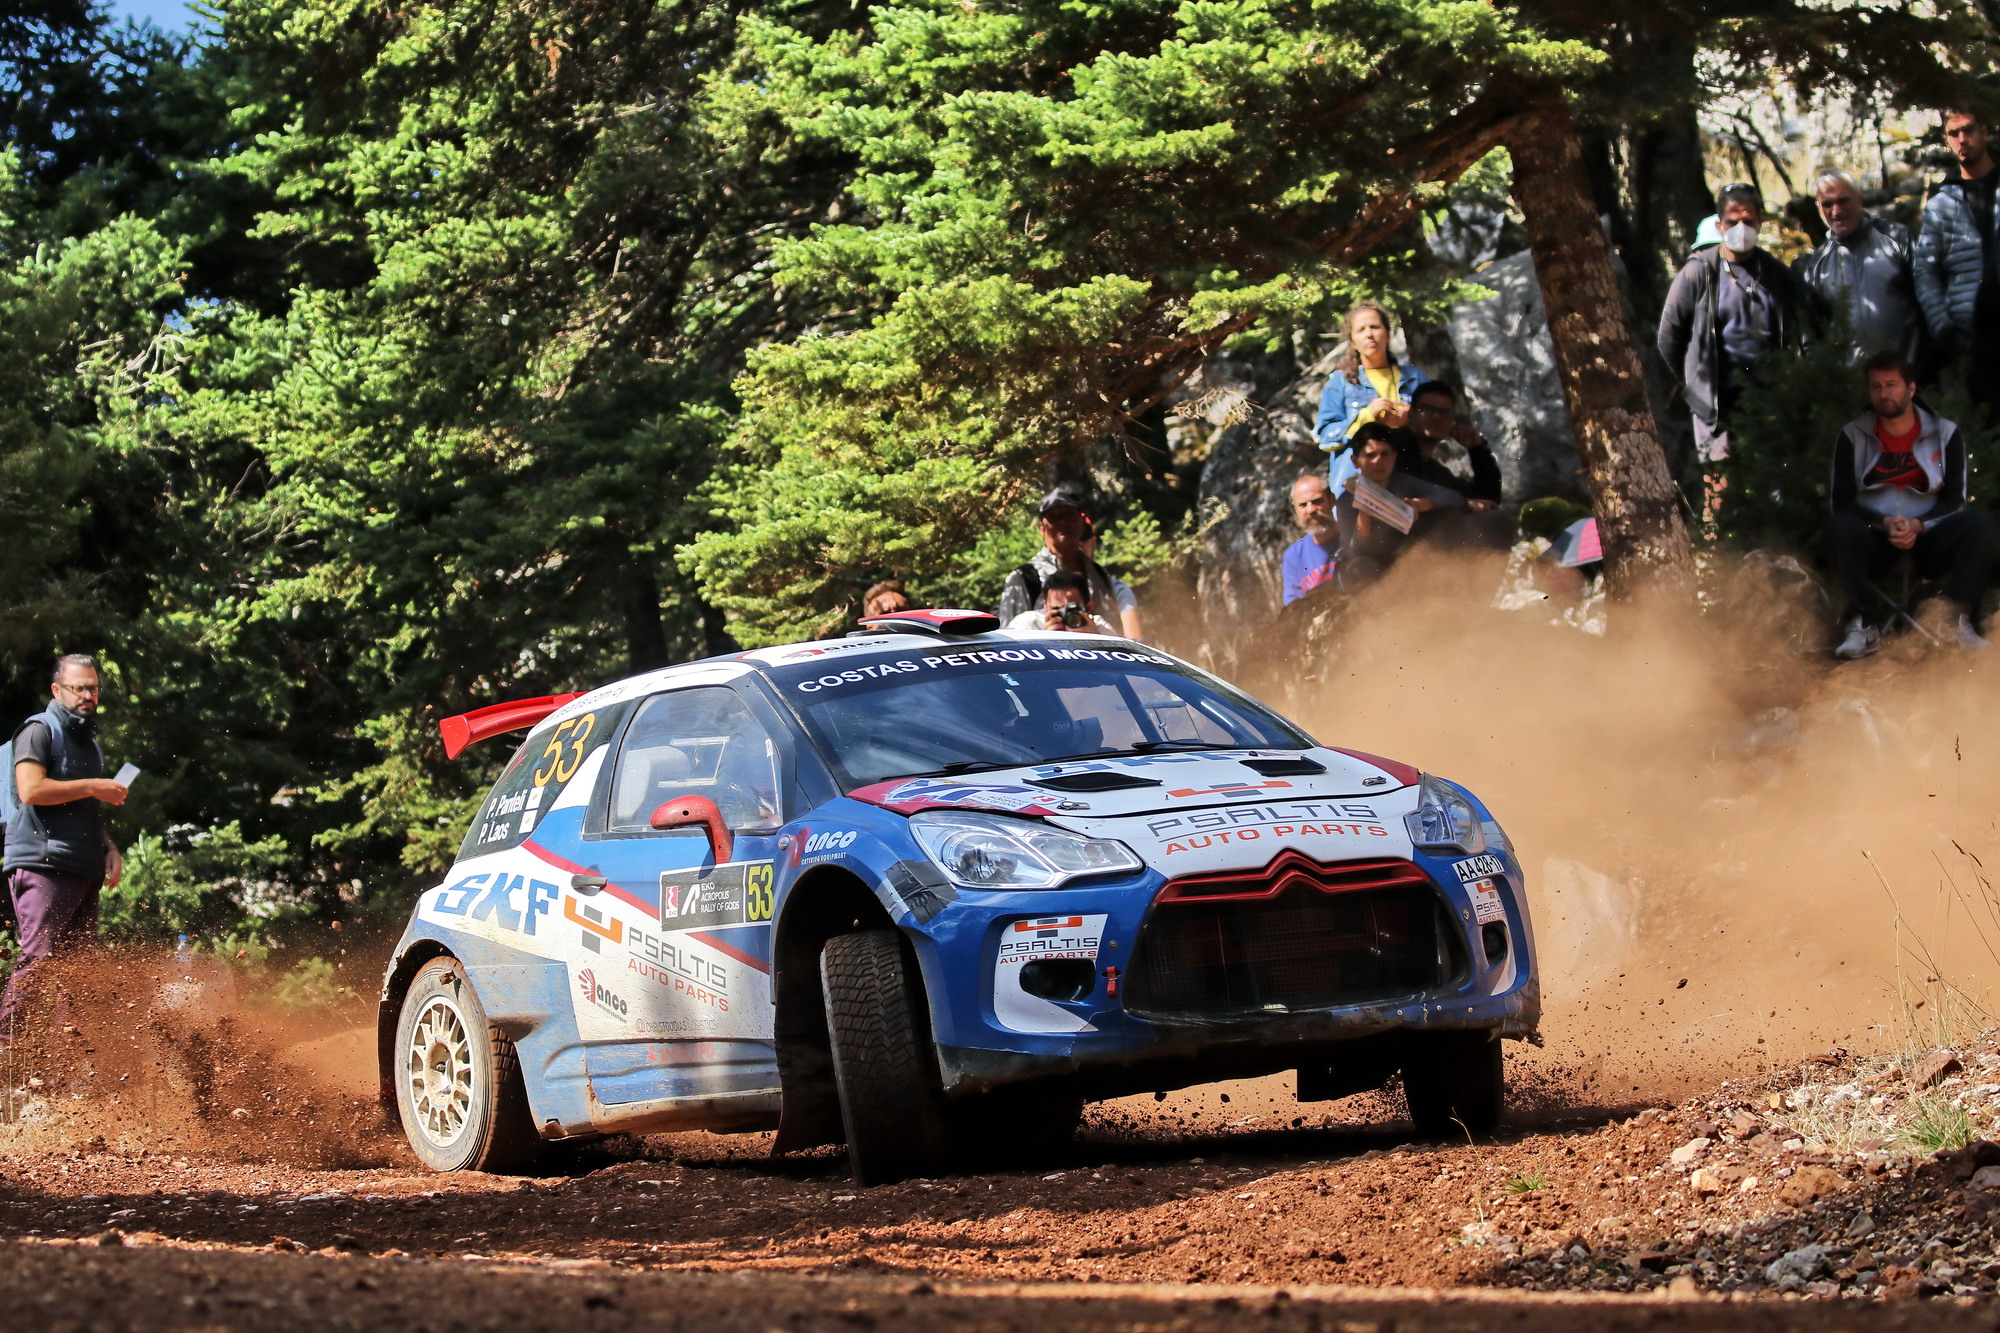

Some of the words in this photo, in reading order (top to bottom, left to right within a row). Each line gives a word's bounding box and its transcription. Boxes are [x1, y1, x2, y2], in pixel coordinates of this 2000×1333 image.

[798, 661, 919, 692] COSTAS
[922, 649, 1045, 669] PETROU
[1047, 649, 1175, 666] MOTORS
[534, 713, 595, 787] 53
[486, 797, 495, 820] P.
[495, 789, 528, 816] Panteli
[477, 823, 487, 845] P.
[487, 821, 510, 843] Laos
[1147, 804, 1378, 837] PSALTIS
[805, 831, 857, 853] anco
[1165, 830, 1261, 855] AUTO
[1273, 824, 1388, 837] PARTS
[701, 882, 715, 891] EKO
[1456, 862, 1477, 881] AA
[433, 873, 559, 936] SKF
[701, 890, 730, 902] ACROPOLIS
[701, 902, 716, 913] RALLY
[716, 902, 724, 912] OF
[724, 900, 740, 910] GODS
[748, 864, 774, 920] 53
[629, 927, 727, 989] PSALTIS
[1000, 954, 1038, 964] AUTO
[1044, 951, 1097, 959] PARTS
[1001, 937, 1098, 954] PSALTIS
[597, 984, 627, 1015] anco
[628, 958, 668, 986] AUTO
[675, 979, 729, 1012] PARTS
